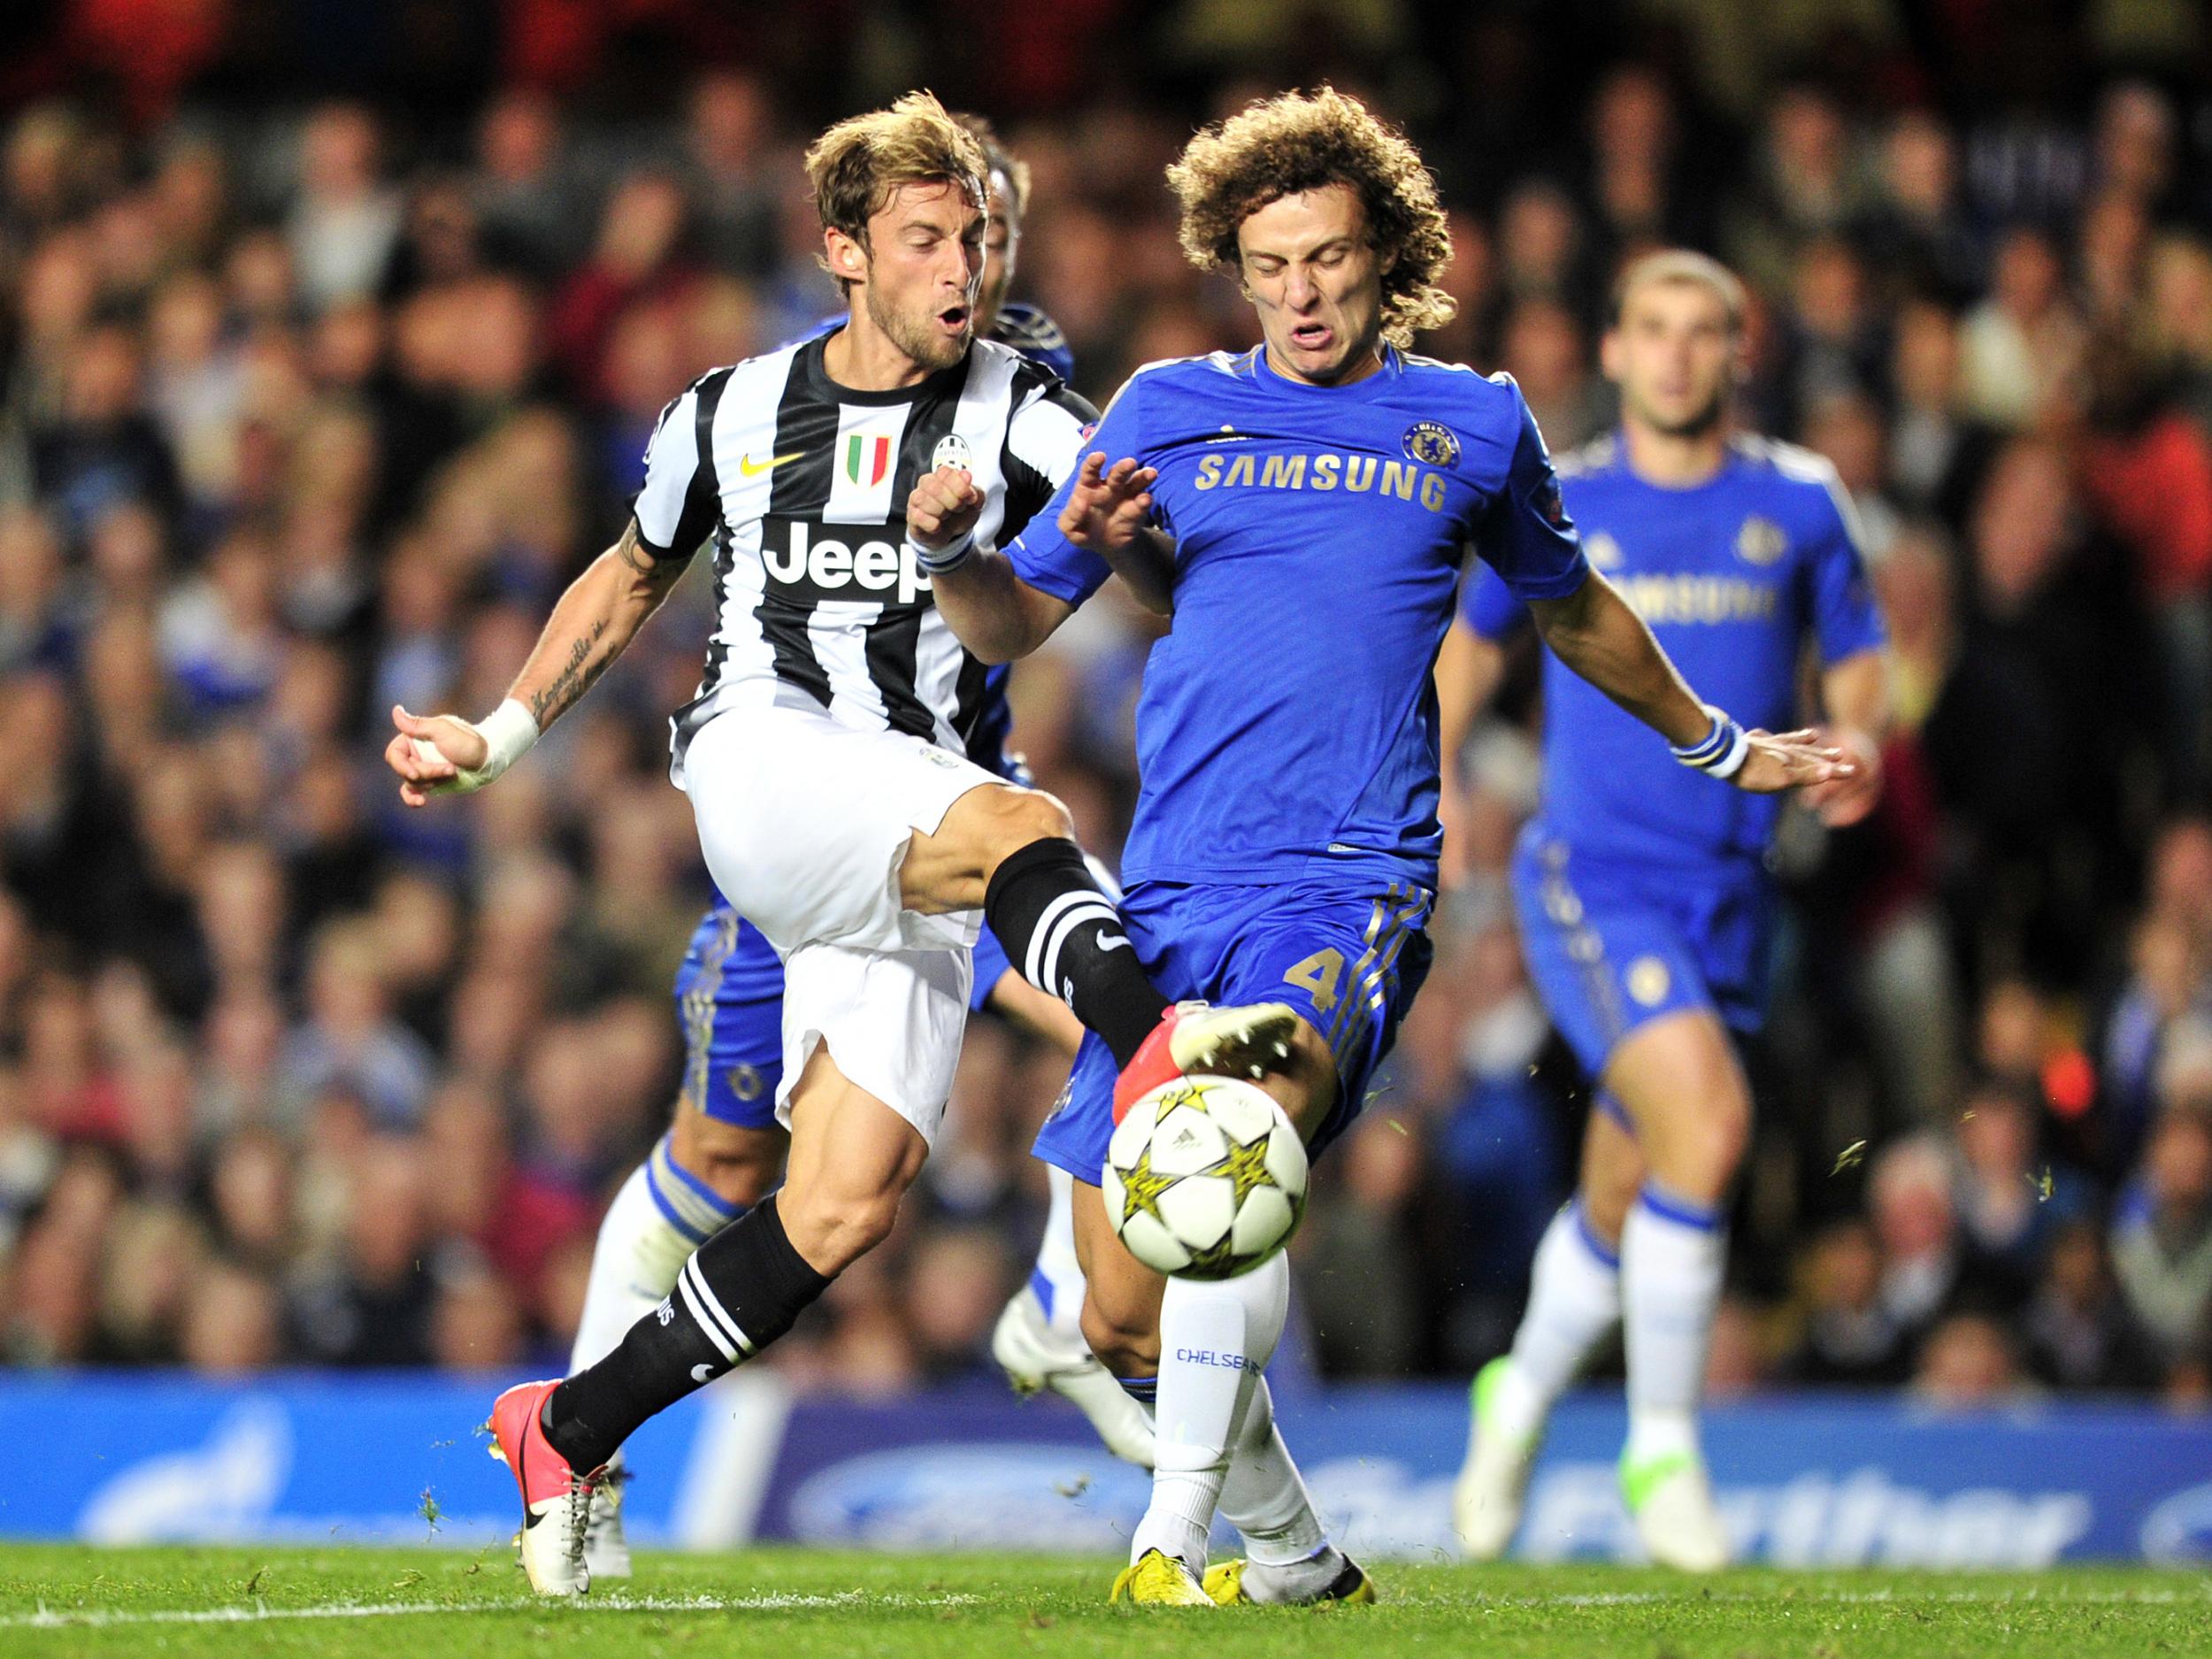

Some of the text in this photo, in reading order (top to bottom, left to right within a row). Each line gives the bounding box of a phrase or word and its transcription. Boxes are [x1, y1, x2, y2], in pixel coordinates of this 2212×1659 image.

[1194, 455, 1446, 512] SAMSUNG
[762, 522, 933, 603] Jeep
[1282, 947, 1344, 1013] 4
